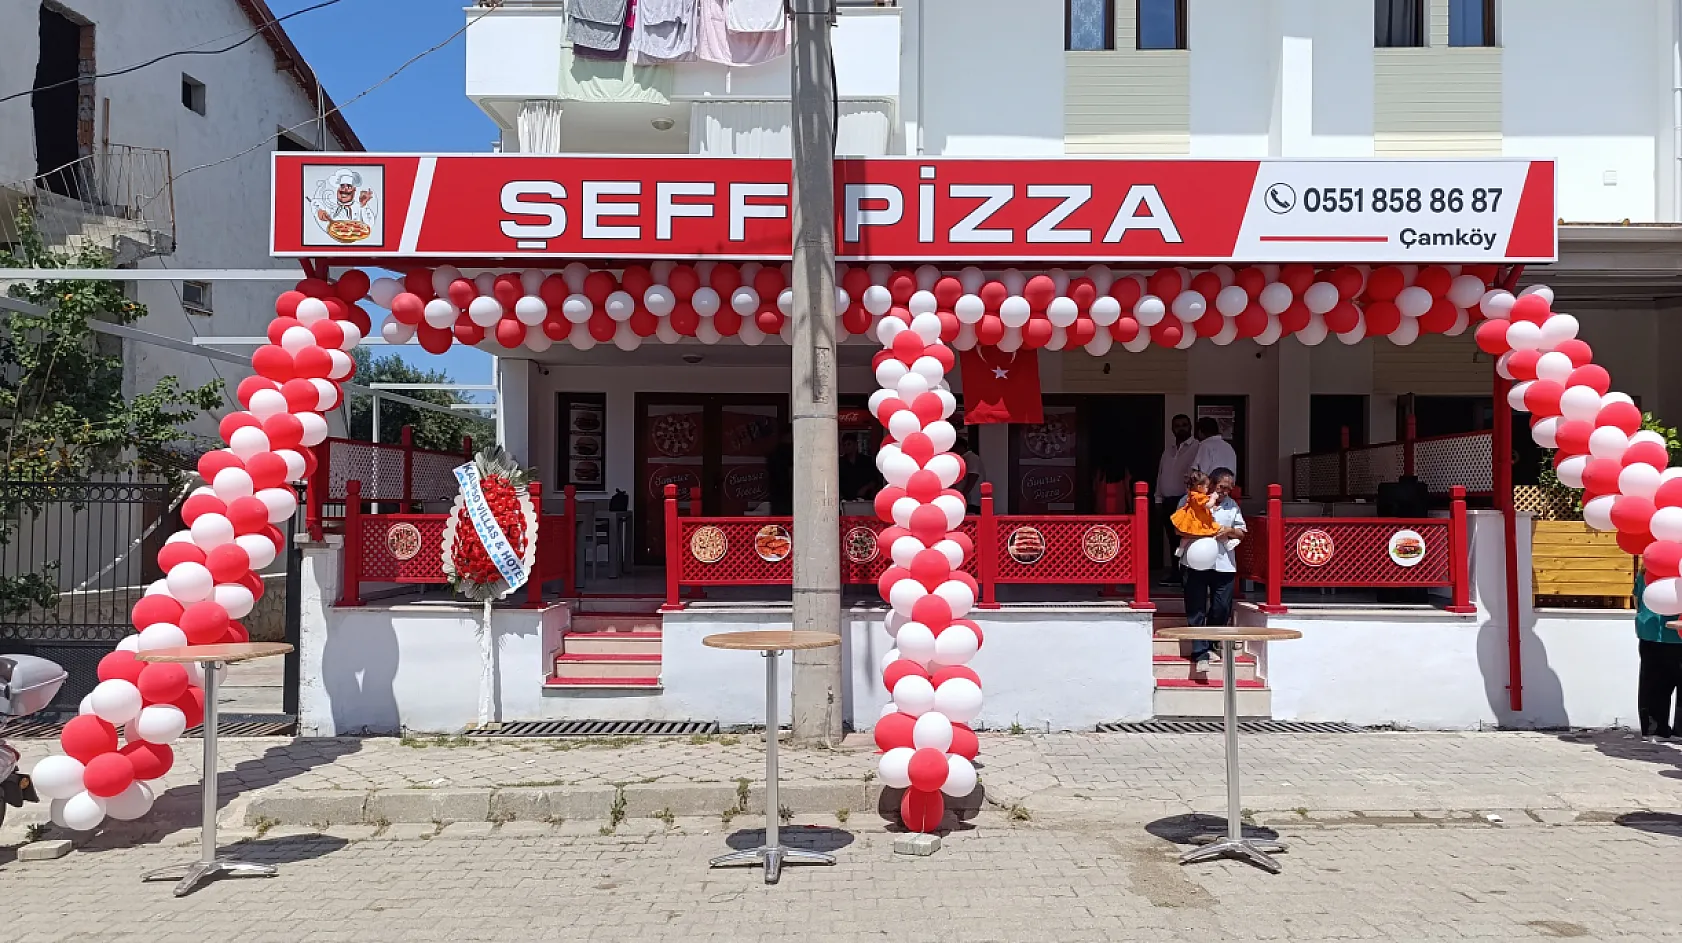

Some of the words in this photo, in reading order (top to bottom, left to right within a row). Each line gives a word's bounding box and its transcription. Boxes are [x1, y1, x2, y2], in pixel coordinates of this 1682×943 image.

[499, 180, 789, 250] ŞEFF
[843, 165, 1184, 244] PİZZA
[1303, 187, 1364, 213] 0551
[1371, 187, 1422, 213] 858
[1429, 187, 1464, 213] 86
[1471, 187, 1503, 213] 87
[1399, 227, 1497, 251] Çamköy
[494, 541, 505, 551] &
[501, 550, 526, 584] HOTEL
